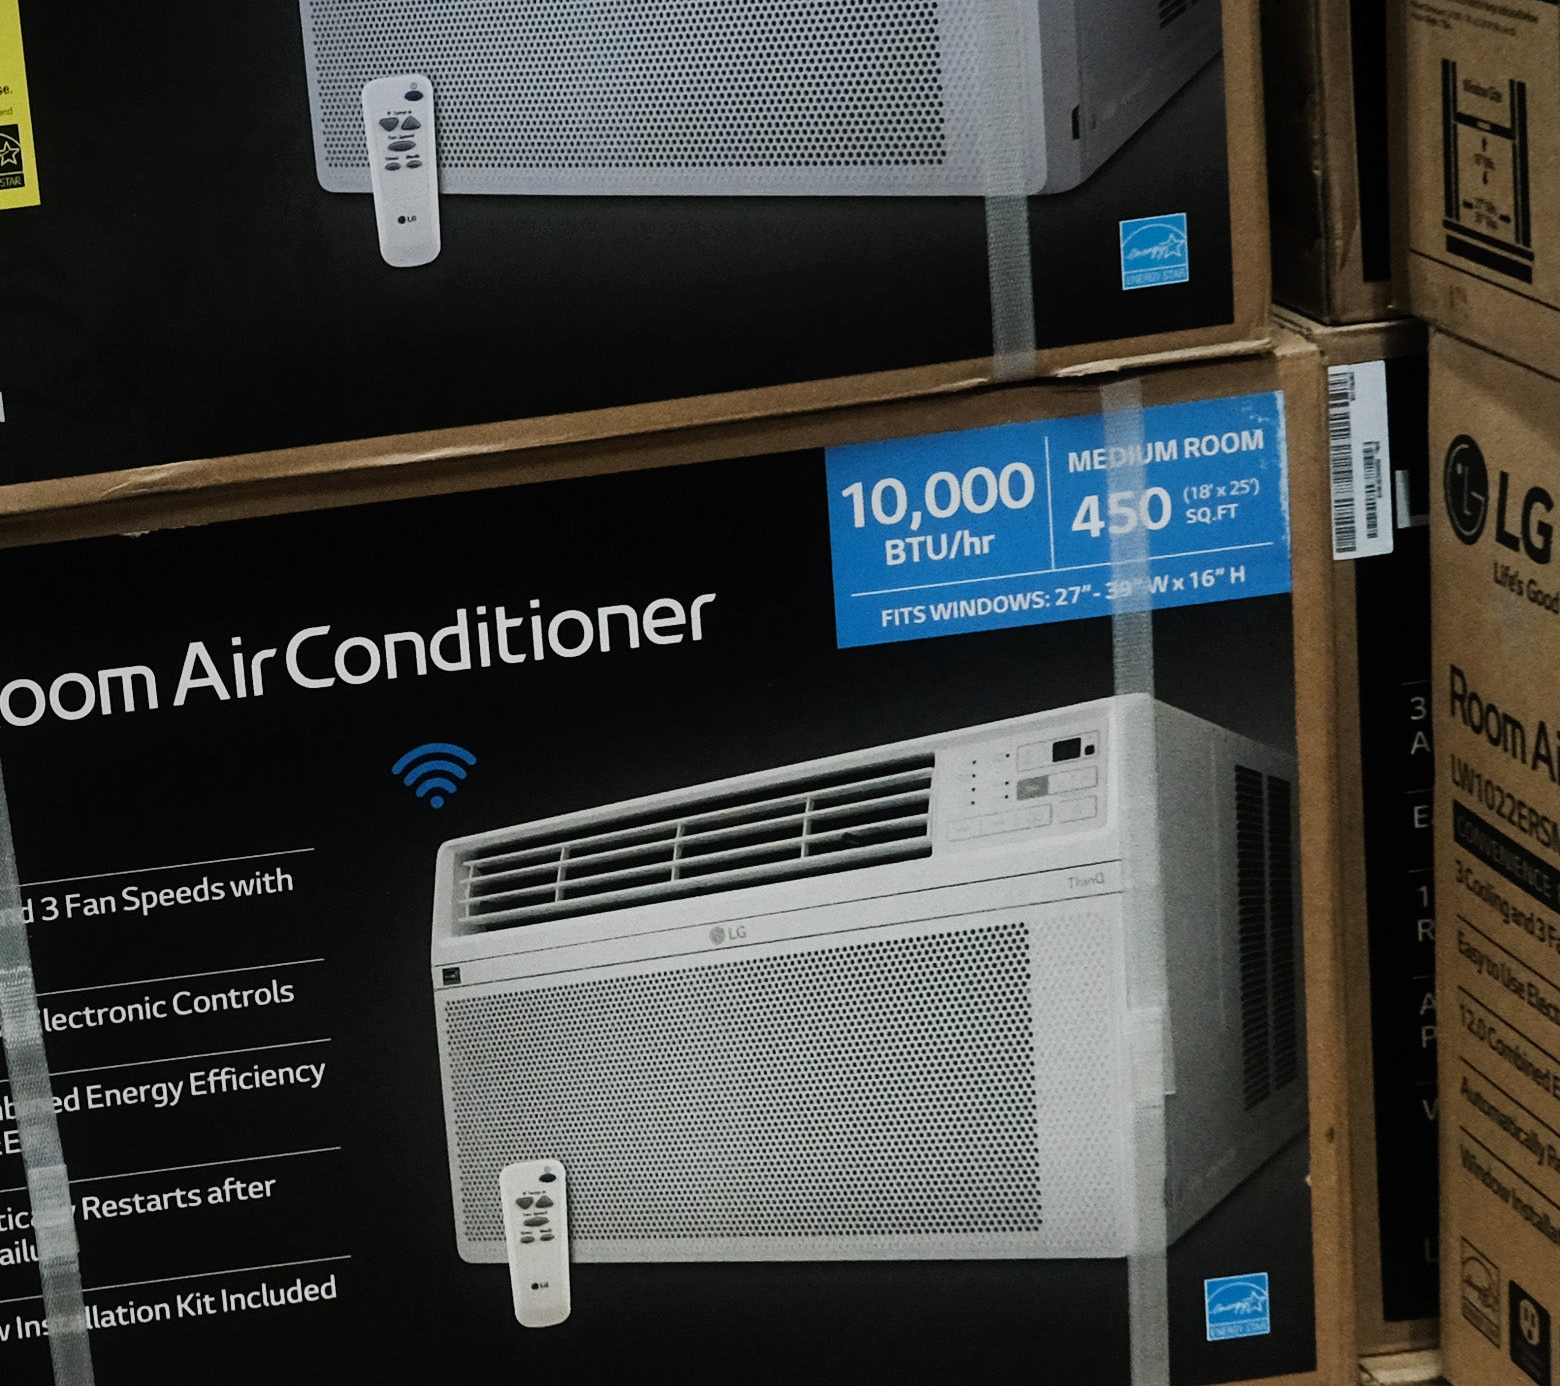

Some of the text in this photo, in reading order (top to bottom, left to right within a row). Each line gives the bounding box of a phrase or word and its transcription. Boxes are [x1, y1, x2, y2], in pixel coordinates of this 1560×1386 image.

[1069, 430, 1265, 473] MEDIUM ROOM
[841, 461, 1035, 534] 10,000
[1071, 487, 1172, 538] 450
[1186, 503, 1238, 525] SQ.FT
[1494, 469, 1553, 565] LG
[885, 530, 995, 566] BTU/hr
[881, 606, 925, 627] FITS
[930, 591, 1049, 622] WINDOWS:
[1493, 561, 1560, 613] Life's Good
[173, 635, 277, 708] Air
[285, 592, 717, 690] Conditioner
[1449, 665, 1527, 760] Room
[40, 896, 58, 921] 3
[65, 892, 116, 918] Fan
[122, 875, 224, 914] Speeds
[229, 868, 295, 896] with
[172, 979, 295, 1017] Controls
[86, 1080, 184, 1114] Energy
[188, 1056, 327, 1097] Efficiency
[81, 1174, 276, 1221] Restarts after
[176, 1294, 217, 1322] Kit
[221, 1274, 338, 1315] Included
